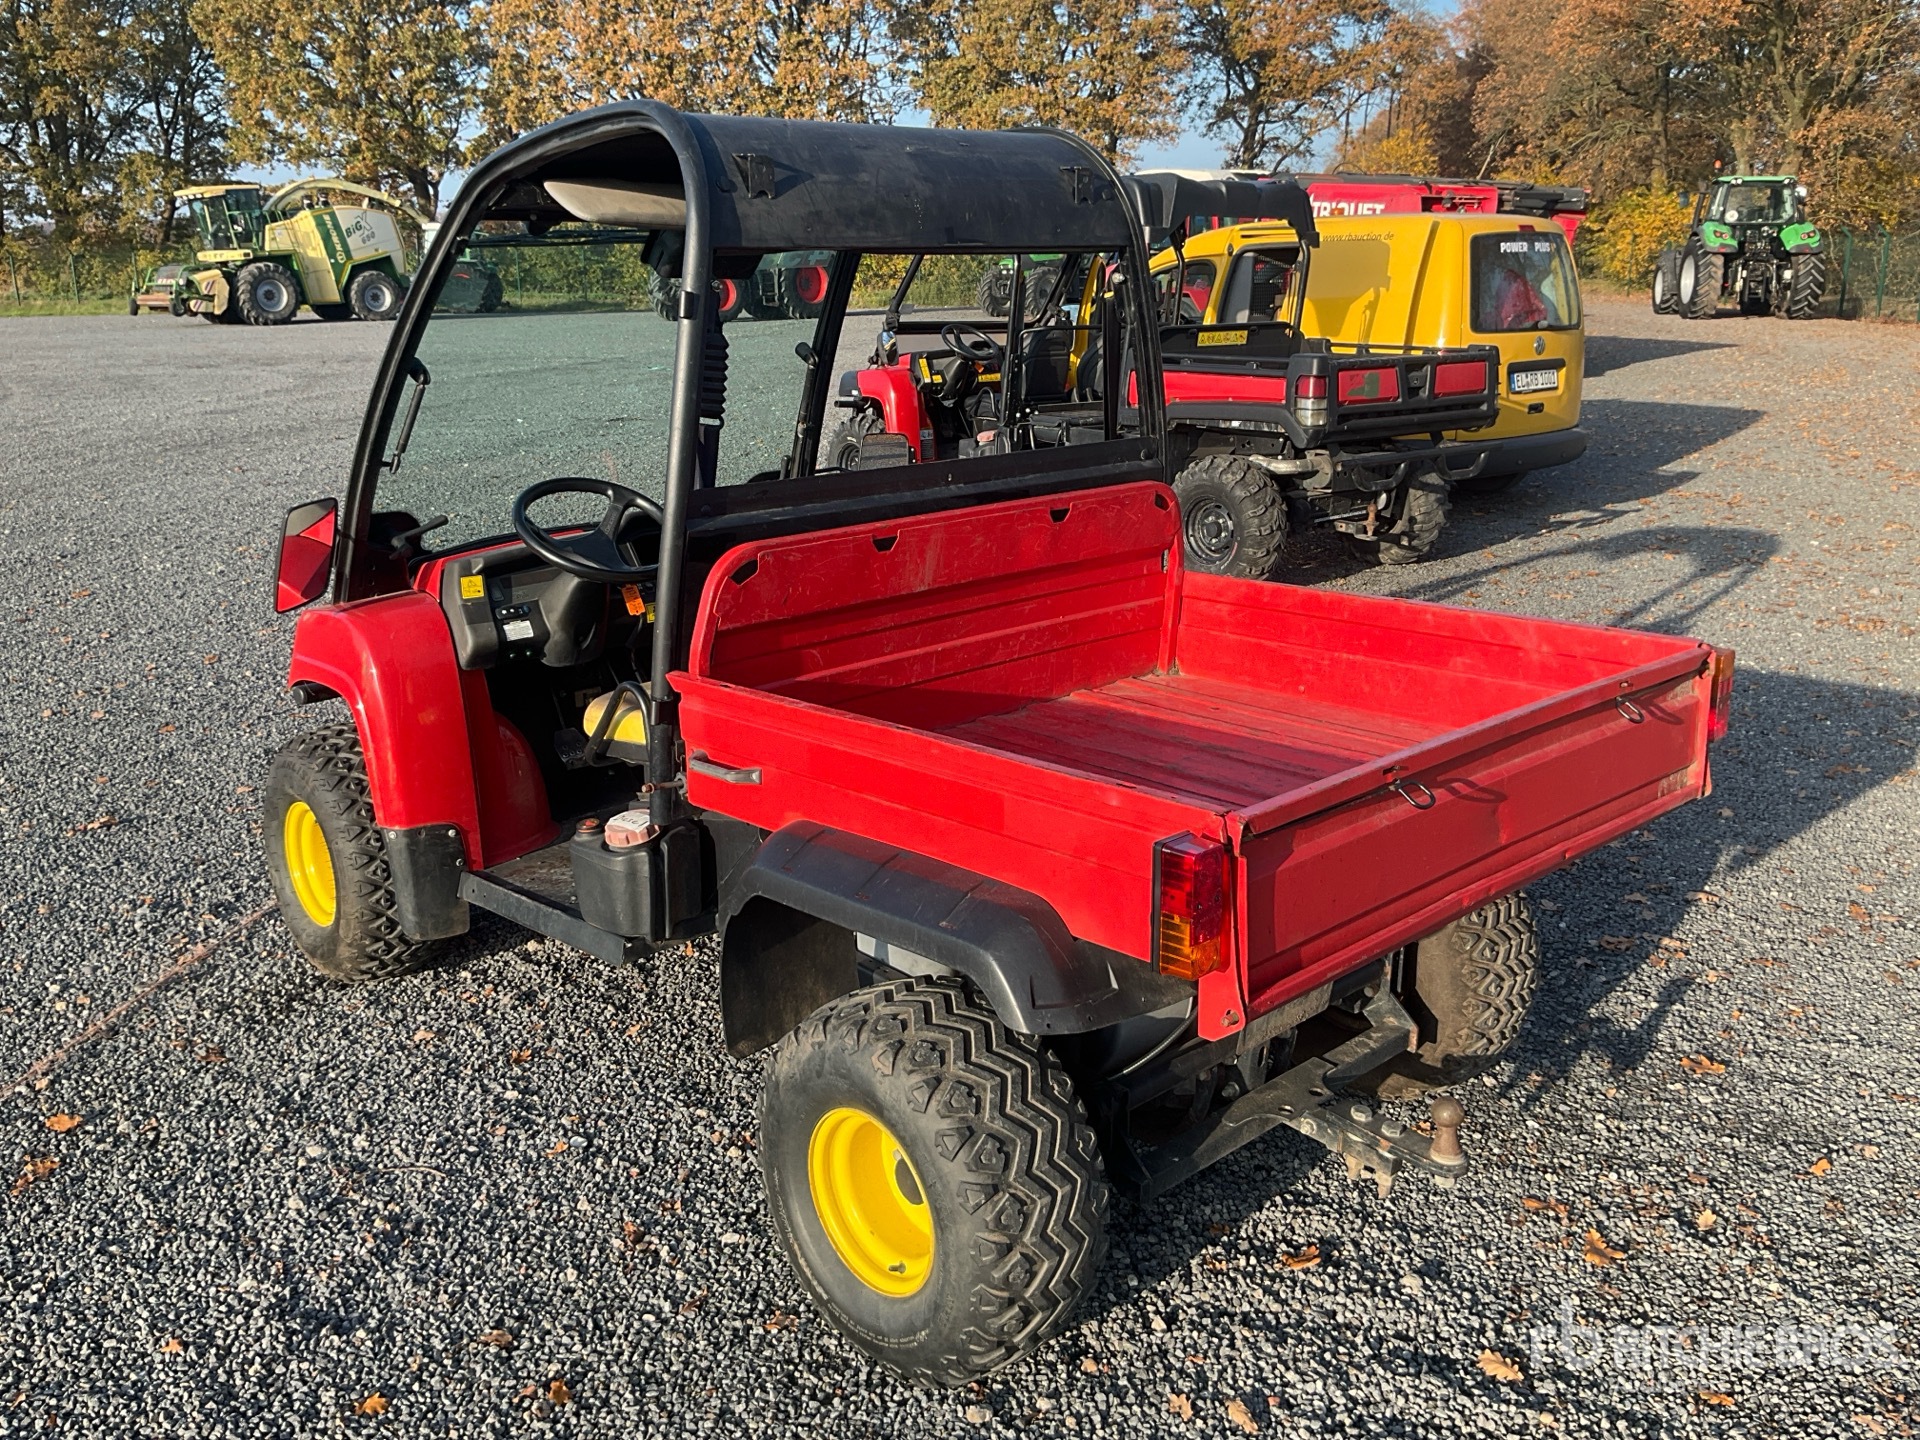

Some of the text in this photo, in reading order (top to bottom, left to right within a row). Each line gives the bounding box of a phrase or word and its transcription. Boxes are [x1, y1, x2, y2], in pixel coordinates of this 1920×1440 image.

[1322, 231, 1394, 242] www.rbauction.de
[1500, 242, 1550, 253] POWER PLUS
